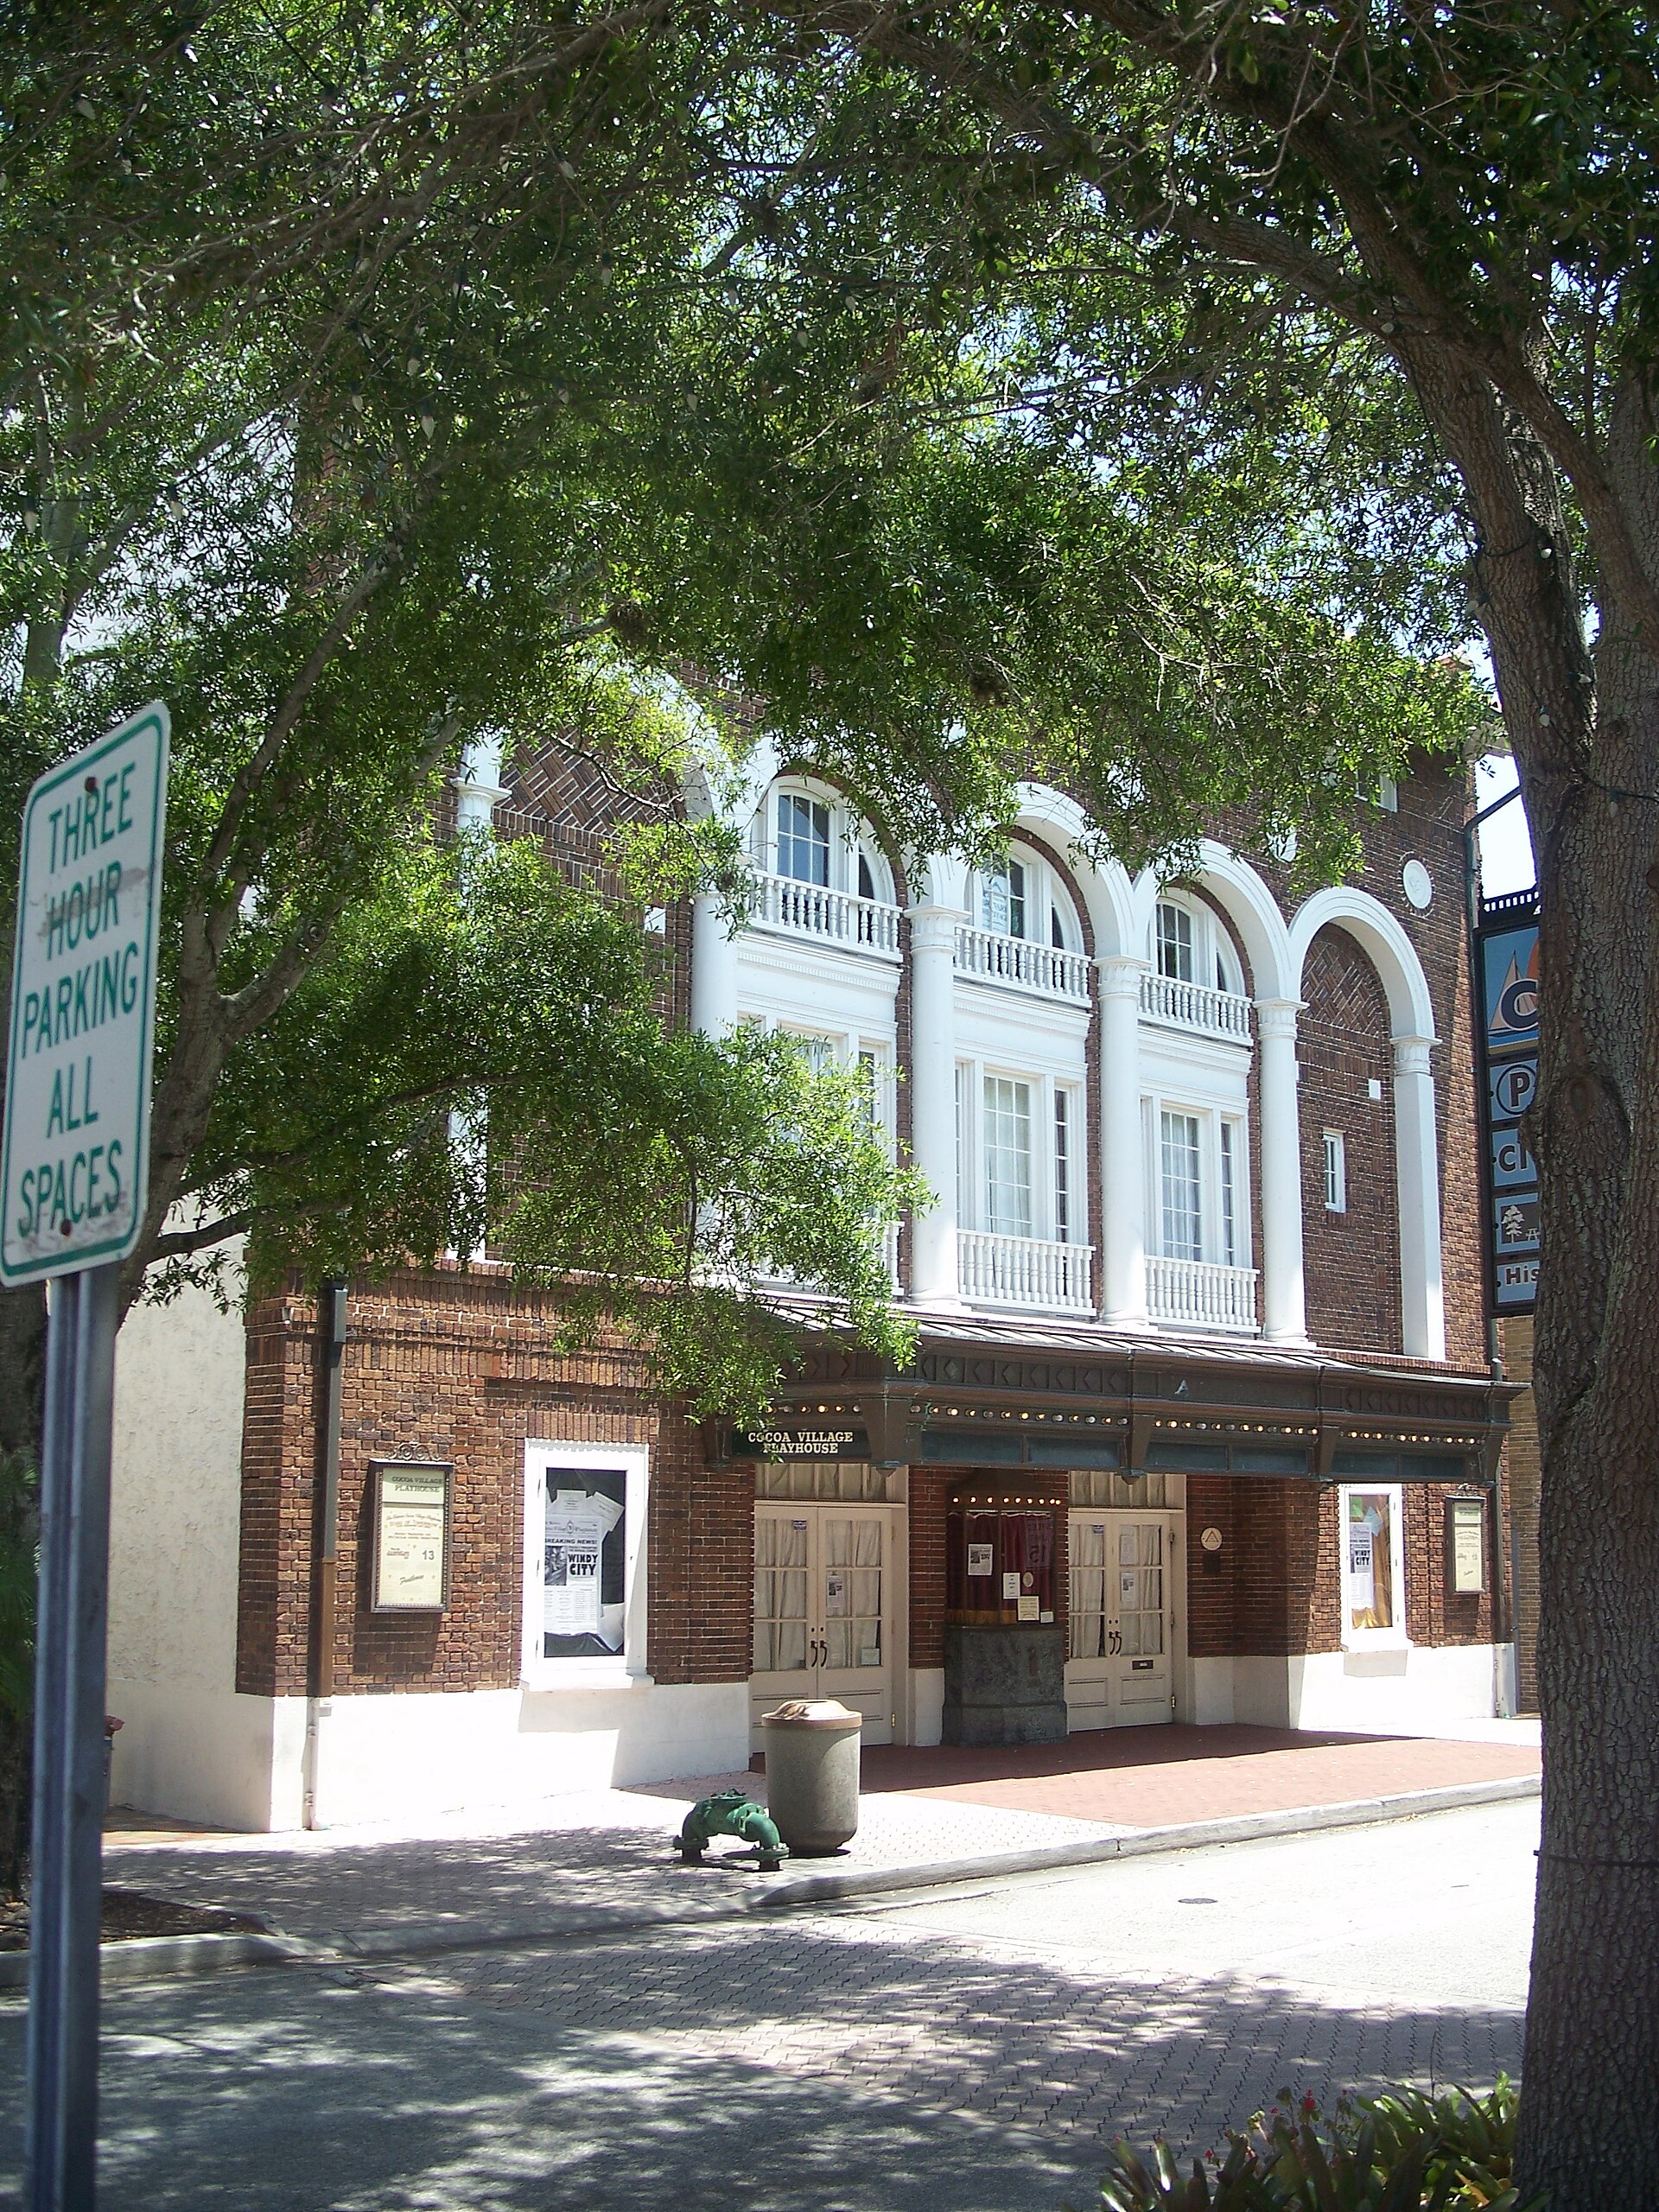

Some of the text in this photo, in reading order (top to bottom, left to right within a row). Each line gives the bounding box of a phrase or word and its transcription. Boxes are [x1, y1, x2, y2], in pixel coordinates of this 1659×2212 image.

[48, 761, 136, 874] THREE
[47, 860, 122, 962] HOUR
[21, 941, 139, 1060] PARKING
[46, 1055, 99, 1140] ALL
[1509, 1071, 1531, 1108] P
[17, 1139, 123, 1239] SPACES
[747, 1432, 854, 1443] COCOA VILLAGE
[762, 1442, 839, 1454] PLAYHOUSE
[422, 1549, 435, 1560] 13
[568, 1554, 598, 1563] WINDY
[1356, 1557, 1370, 1566] CITY
[569, 1563, 597, 1576] CITY
